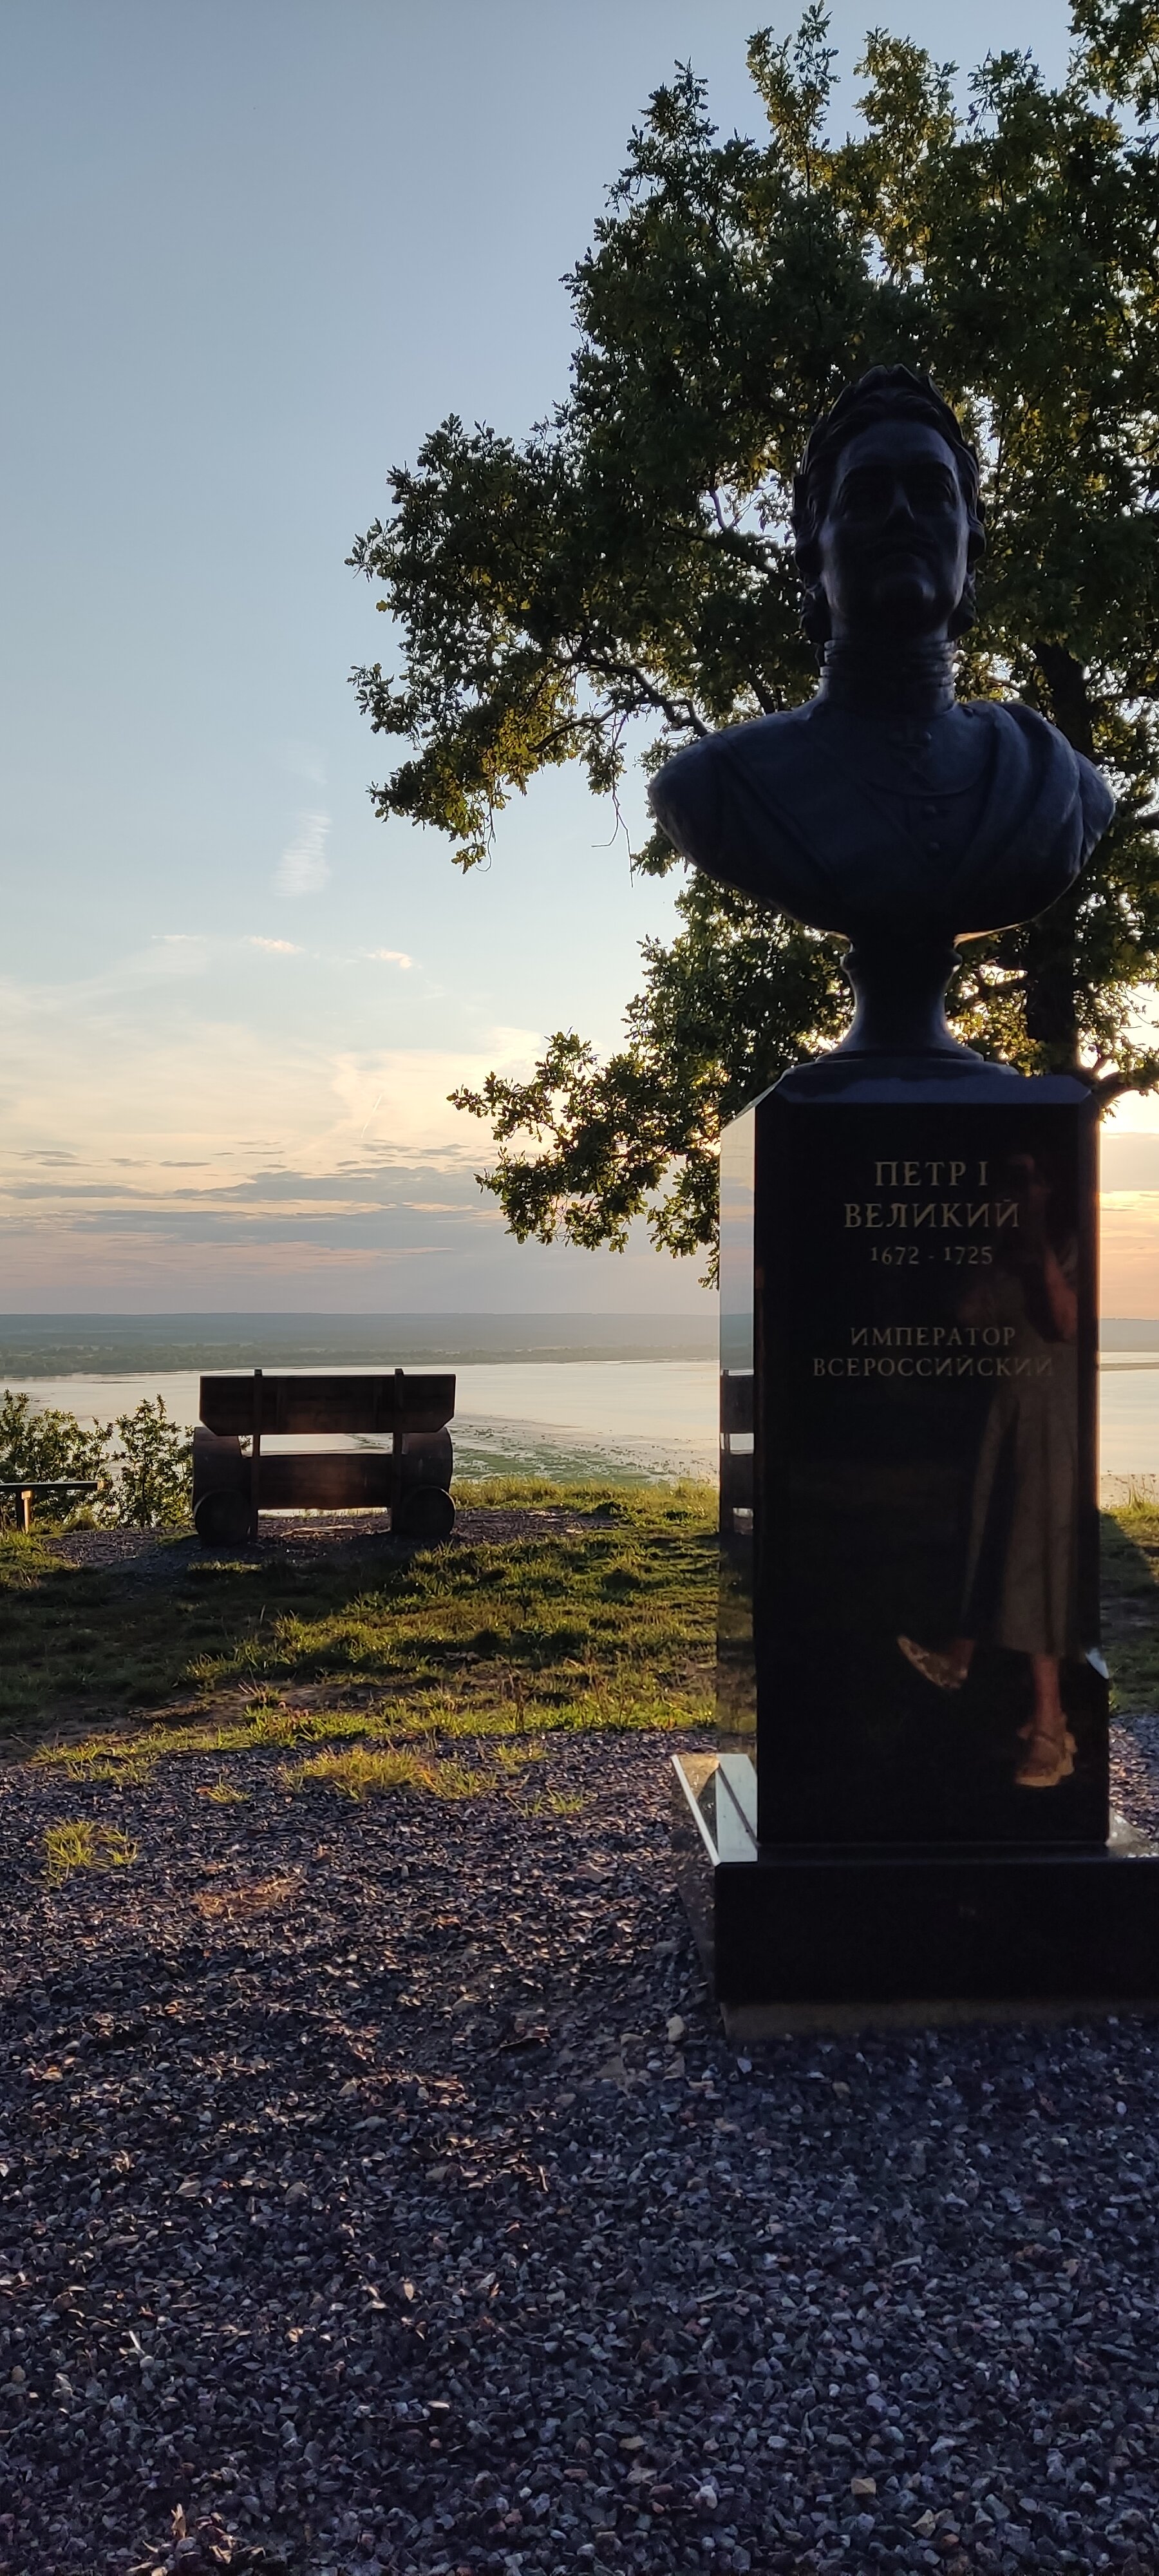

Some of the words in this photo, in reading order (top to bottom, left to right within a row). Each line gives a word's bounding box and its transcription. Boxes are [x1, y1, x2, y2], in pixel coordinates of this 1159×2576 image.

[874, 1160, 966, 1186] ПЕТР
[843, 1198, 1019, 1228] ВЕЛИКИЙ
[870, 1246, 919, 1265] 1672
[944, 1246, 993, 1265] 1725
[850, 1327, 1016, 1346] ИМПЕРАТОР
[813, 1354, 1053, 1377] ВСЕРОССИЙСКИЙ
